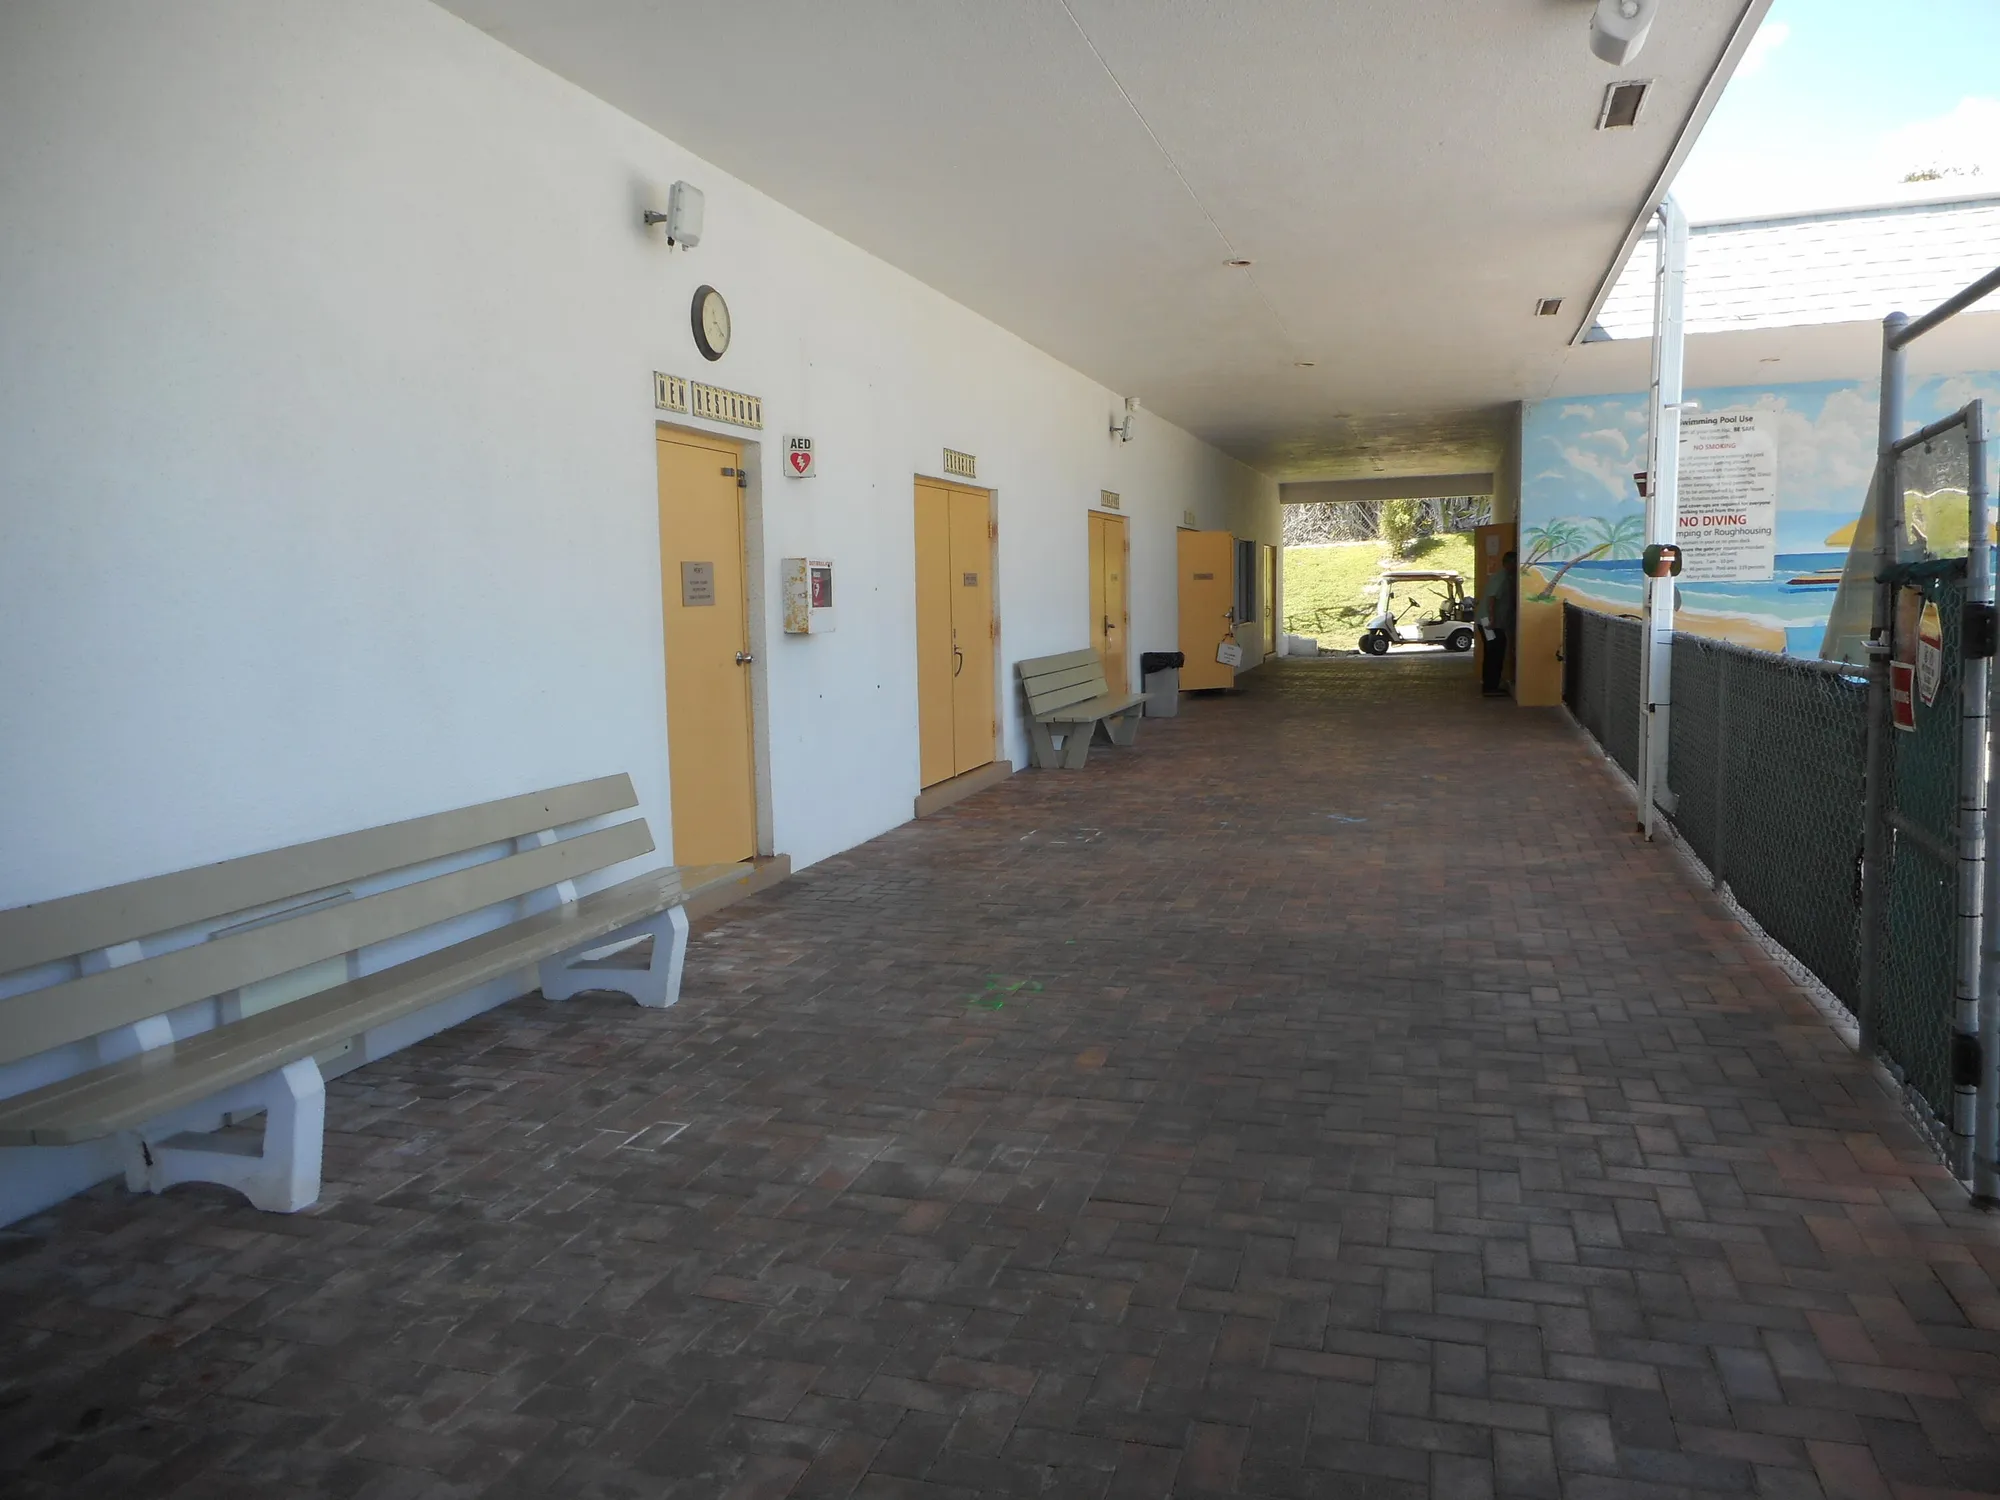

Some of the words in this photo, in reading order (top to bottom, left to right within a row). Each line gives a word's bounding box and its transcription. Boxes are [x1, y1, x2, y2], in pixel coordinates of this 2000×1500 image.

[660, 380, 684, 406] MEN
[697, 389, 761, 422] RESTROOM
[1720, 416, 1737, 424] Pool
[1739, 415, 1753, 423] Use
[790, 438, 811, 449] AED
[1680, 516, 1699, 527] NO
[1703, 514, 1747, 526] DIVING
[1676, 529, 1701, 539] mping
[1715, 527, 1772, 538] Roughhousing
